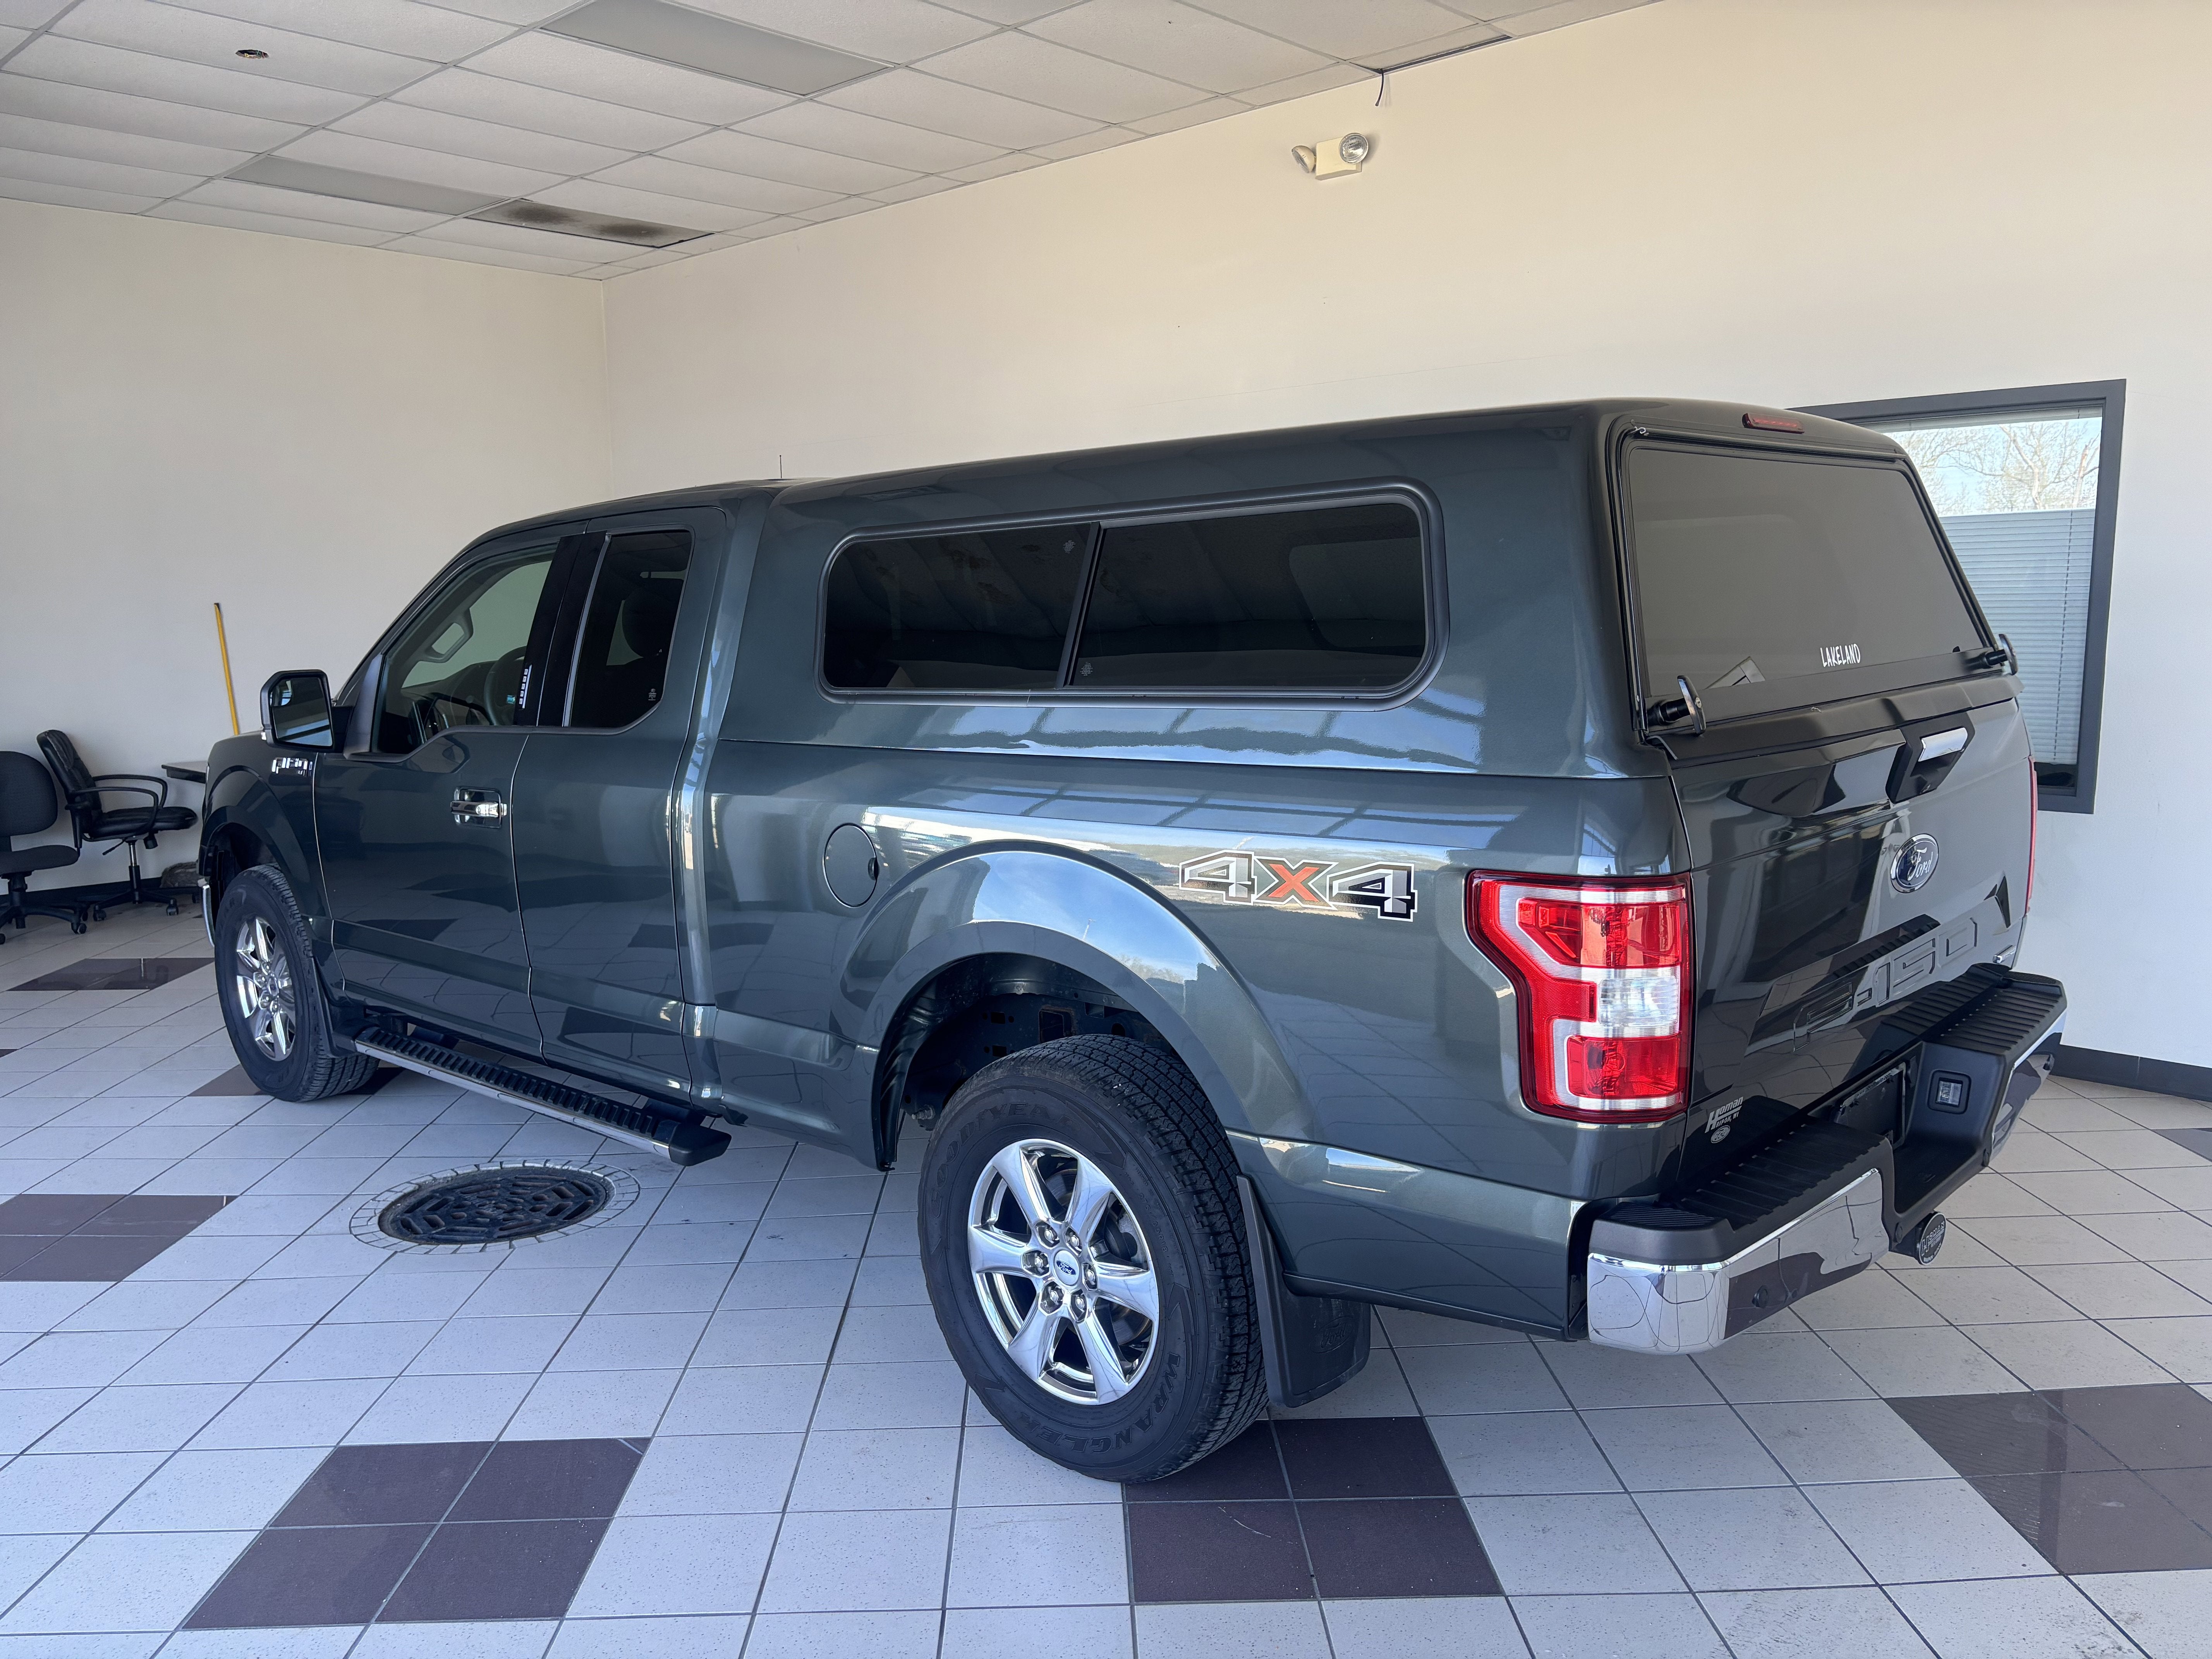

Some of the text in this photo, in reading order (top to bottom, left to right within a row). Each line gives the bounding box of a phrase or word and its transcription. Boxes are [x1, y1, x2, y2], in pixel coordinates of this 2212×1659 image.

[1820, 643, 1861, 667] LAKELAND
[1906, 847, 1934, 881] Ford
[1793, 916, 1978, 1053] F-150
[1704, 1096, 1743, 1133] Homan
[1059, 1262, 1073, 1274] Ford
[1018, 1352, 1181, 1453] WRANGLER
